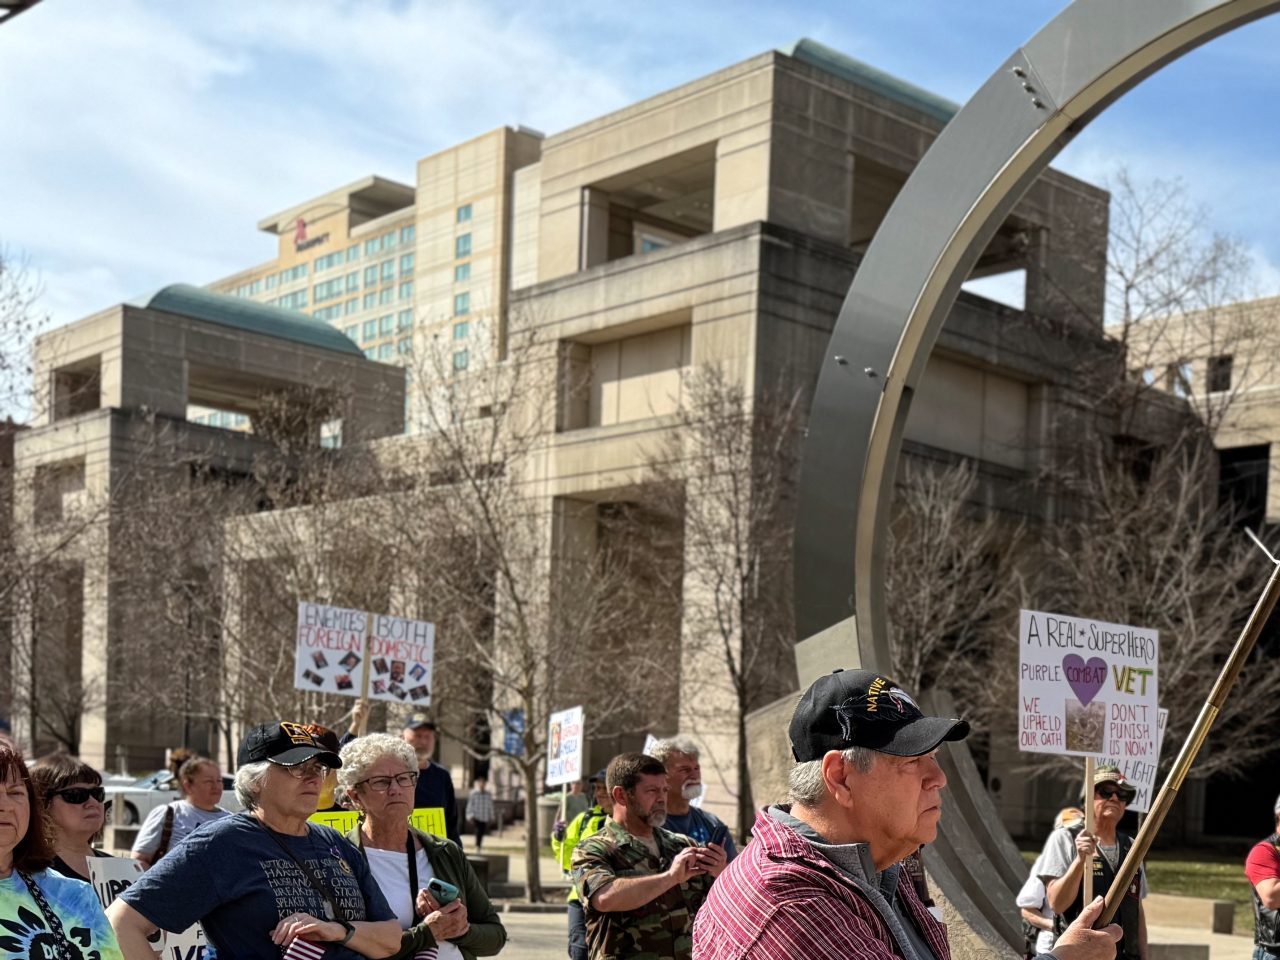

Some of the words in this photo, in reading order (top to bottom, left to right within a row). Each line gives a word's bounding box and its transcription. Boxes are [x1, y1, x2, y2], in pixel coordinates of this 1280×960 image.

[305, 604, 366, 633] ENEMIES
[377, 616, 428, 643] BOTH
[1027, 614, 1042, 648] A
[1046, 617, 1084, 649] REAL
[300, 625, 361, 652] FOREIGN
[367, 635, 430, 664] DOMESTIC
[1021, 663, 1062, 683] PURPLE
[1066, 666, 1106, 685] COMBAT
[1112, 664, 1153, 697] VET
[866, 677, 886, 712] NATIVE
[1023, 696, 1041, 715] WE
[1111, 703, 1149, 722] DON'T
[1022, 715, 1062, 732] UPHELD
[1110, 722, 1151, 740] PUNISH
[1021, 731, 1038, 747] OUR
[1040, 732, 1063, 746] OATH
[1109, 741, 1120, 756] US
